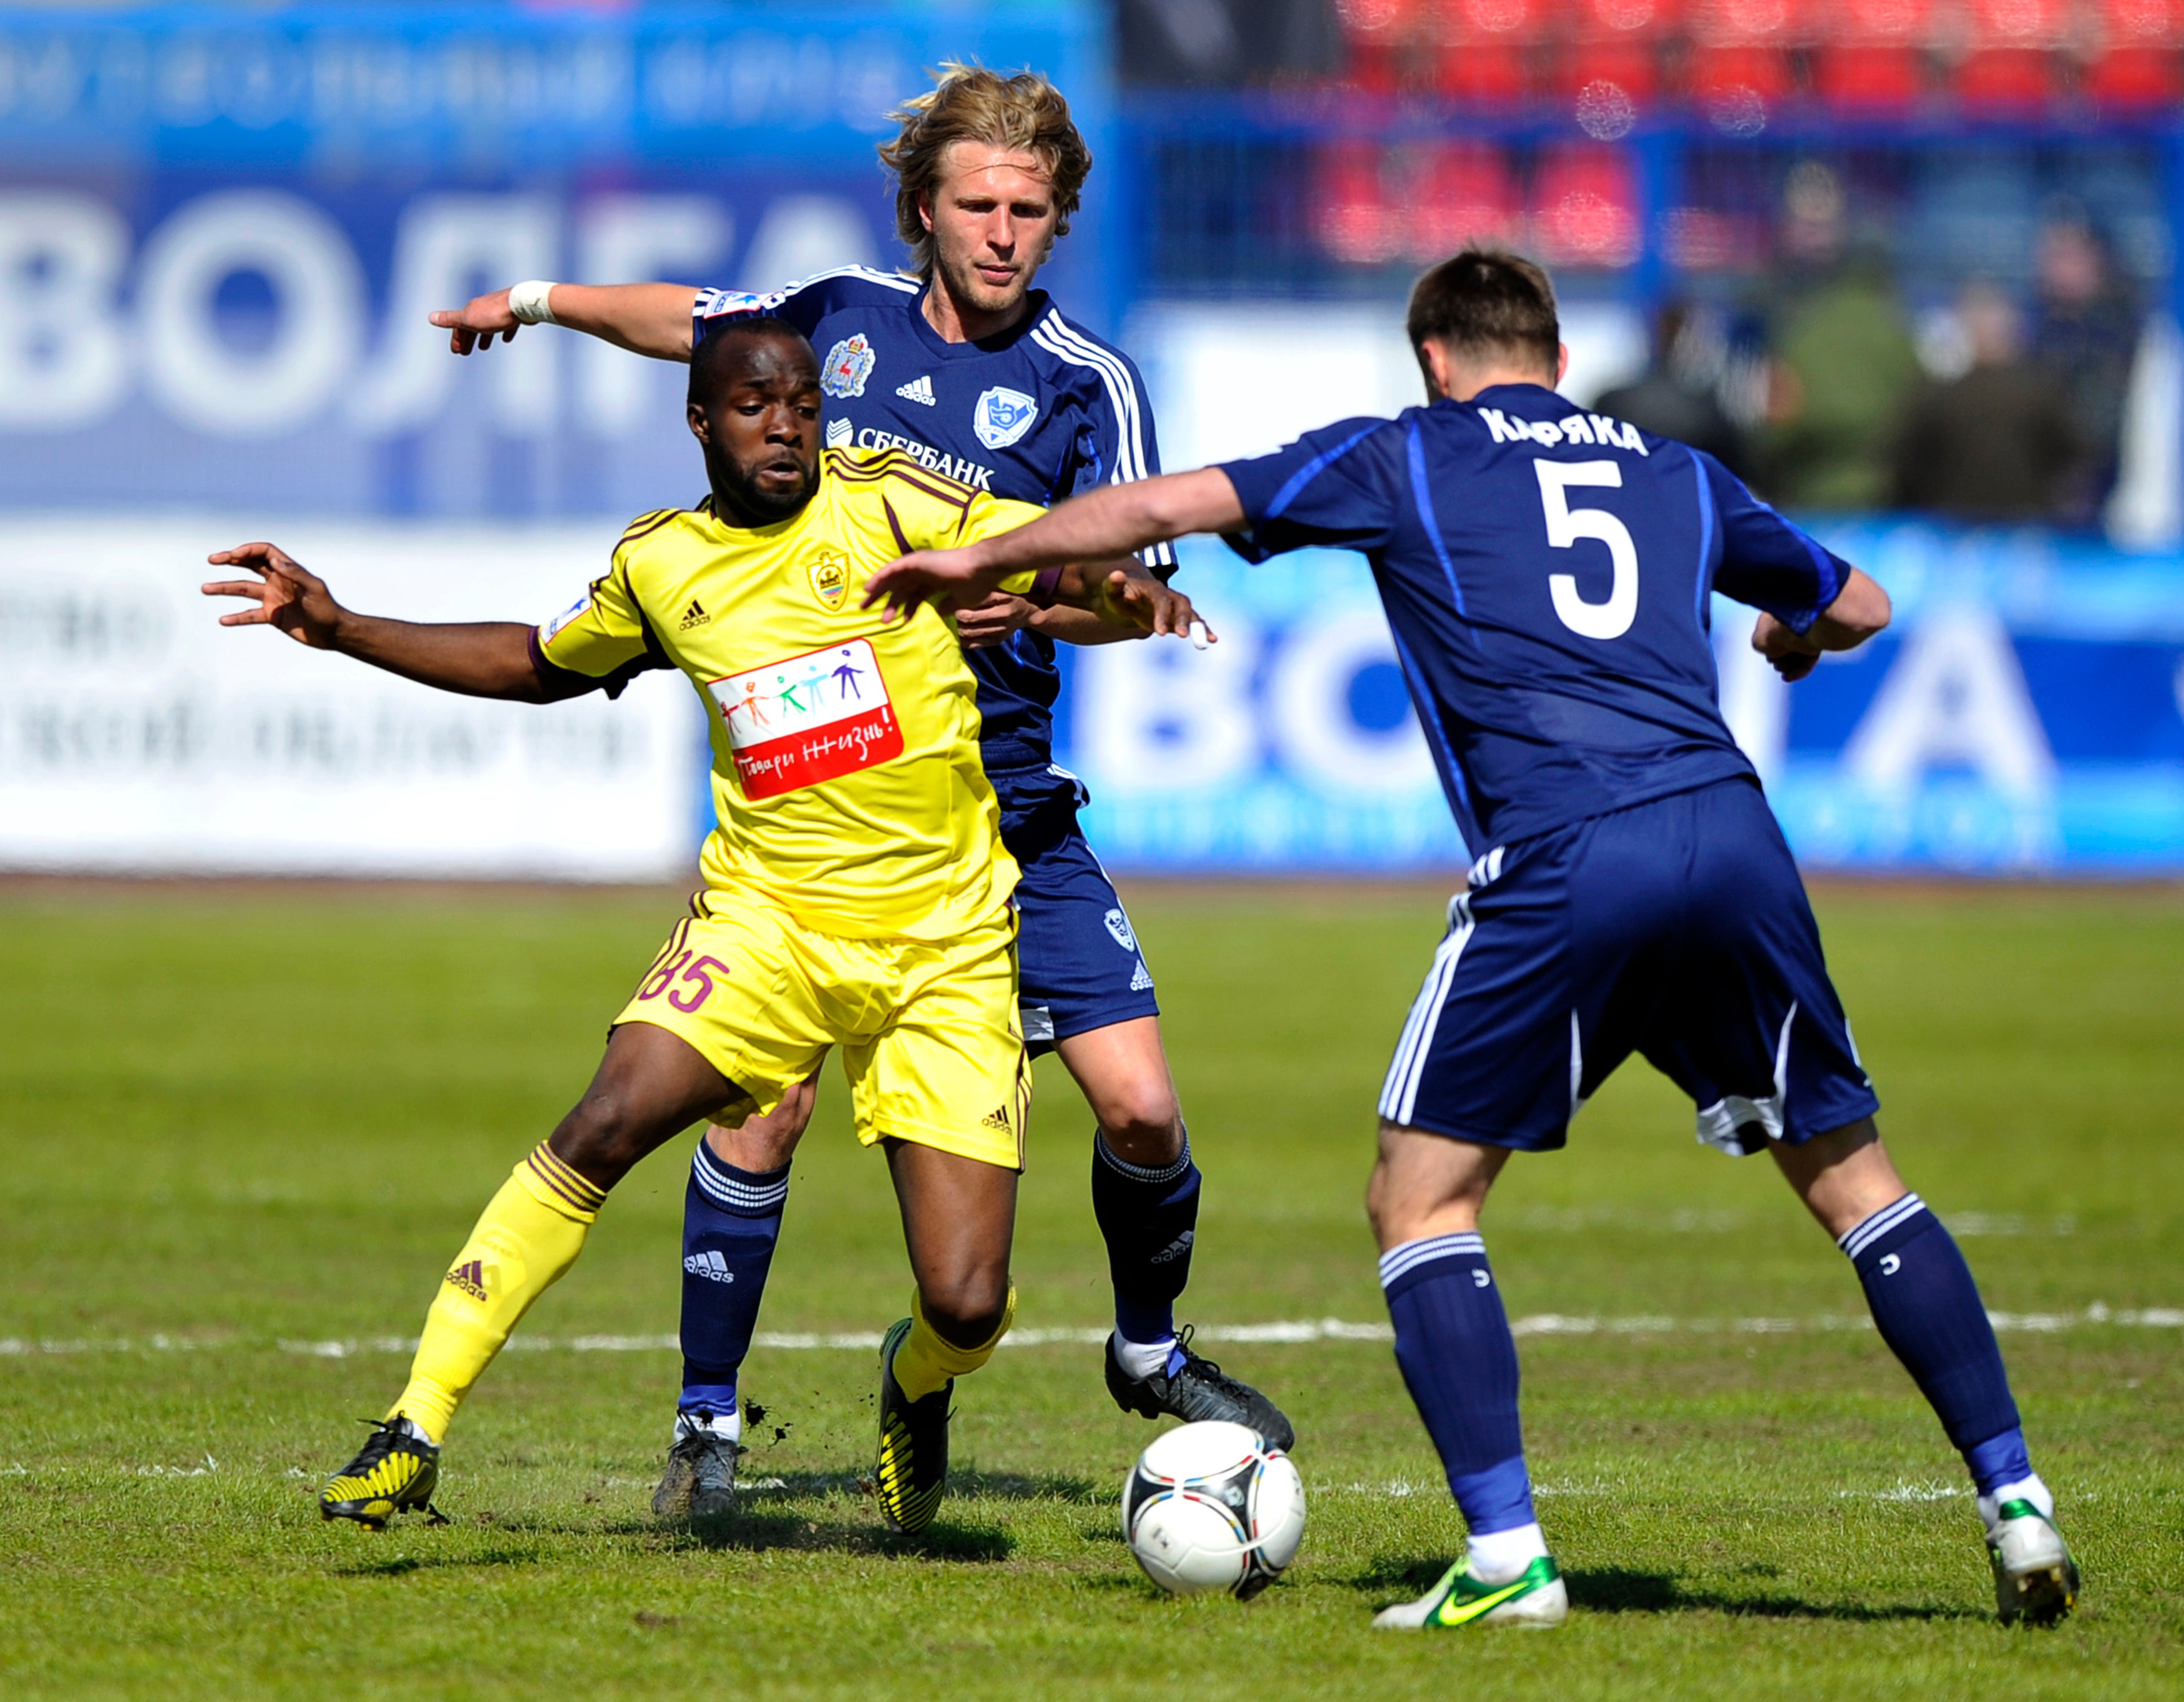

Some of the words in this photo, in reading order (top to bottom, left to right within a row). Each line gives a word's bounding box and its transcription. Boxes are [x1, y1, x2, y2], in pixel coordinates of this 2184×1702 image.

[895, 387, 936, 406] adidas
[1534, 458, 1639, 640] 5
[638, 949, 730, 1014] 85
